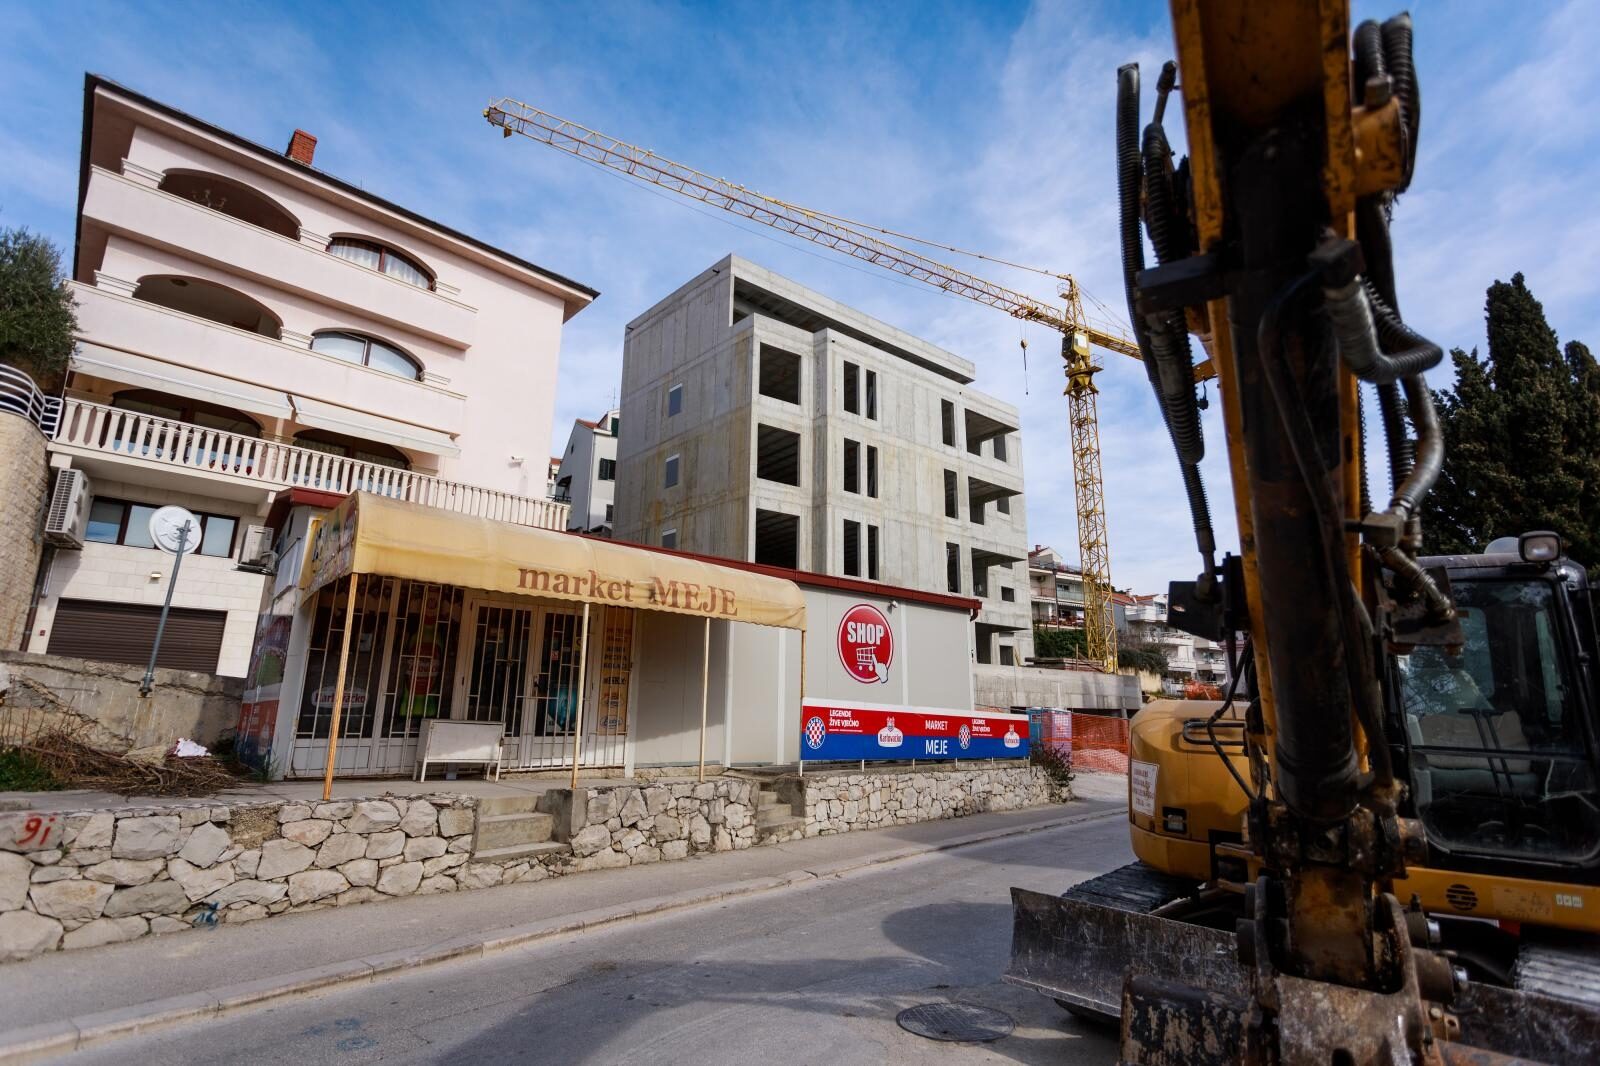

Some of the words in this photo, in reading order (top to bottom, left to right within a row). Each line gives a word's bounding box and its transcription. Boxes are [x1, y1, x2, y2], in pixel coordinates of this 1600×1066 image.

[517, 569, 634, 602] market
[649, 576, 738, 617] MEJE
[847, 621, 885, 645] SHOP
[829, 709, 852, 717] LEGENDE
[925, 720, 948, 730] MARKET
[925, 739, 948, 755] MEJE
